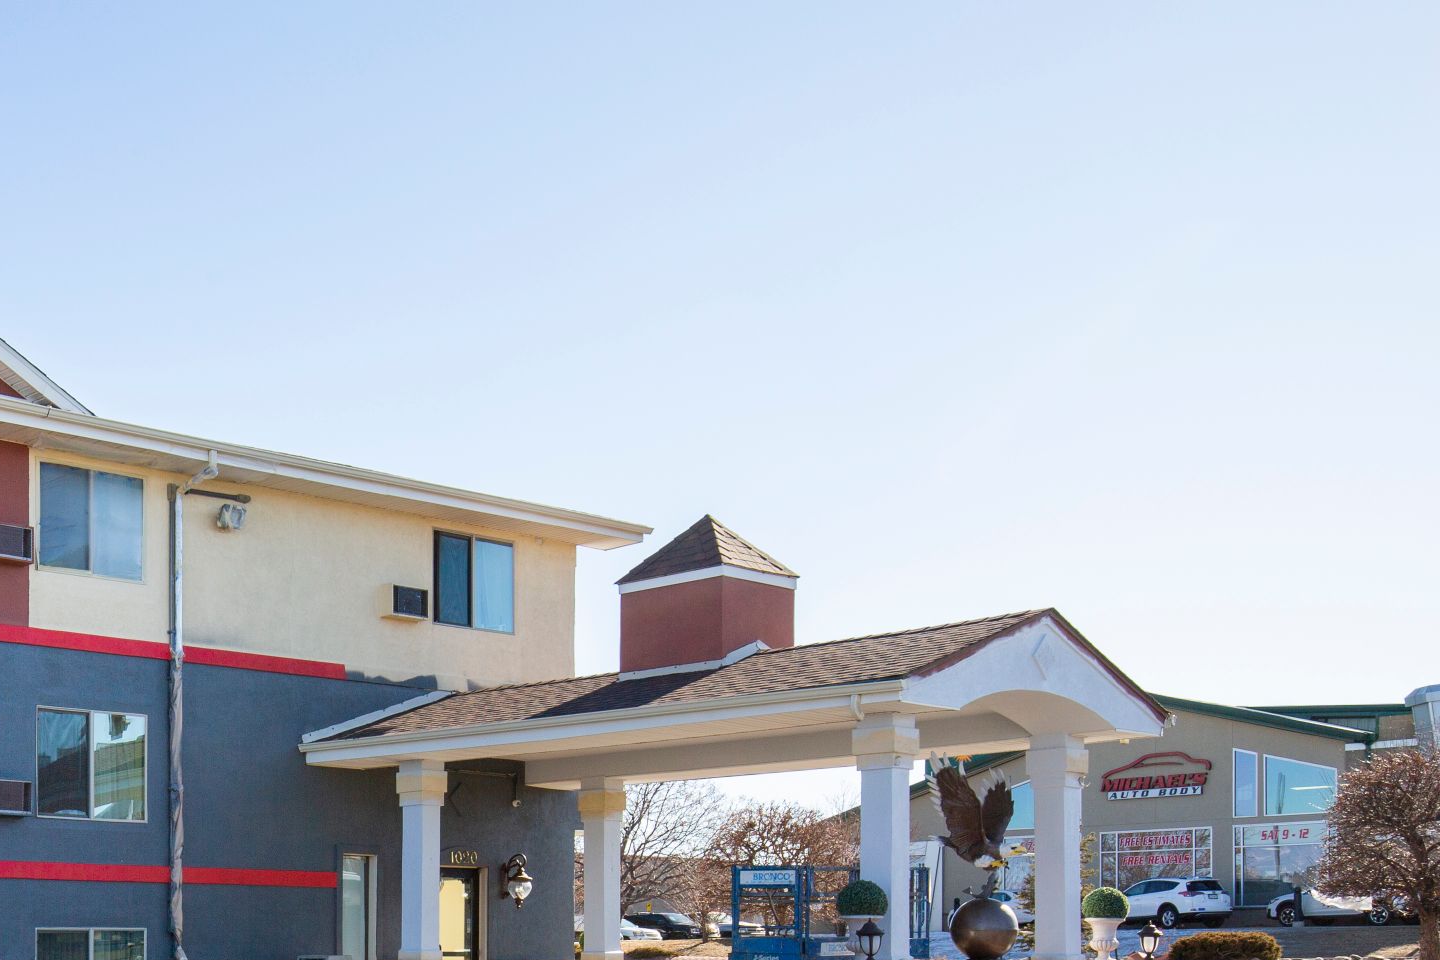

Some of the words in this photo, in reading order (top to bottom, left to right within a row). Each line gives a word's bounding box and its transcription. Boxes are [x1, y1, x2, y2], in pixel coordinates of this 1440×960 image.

[1101, 773, 1208, 792] MICHAEL'S
[1109, 790, 1150, 800] AUTO
[1159, 786, 1200, 796] BODY
[1119, 836, 1141, 848] FREE
[1142, 833, 1191, 847] ESTIMATES
[1260, 830, 1278, 840] SAT
[1282, 829, 1290, 839] 9
[1299, 828, 1309, 839] 12
[451, 850, 478, 864] 1020
[1122, 855, 1144, 866] FREE
[1147, 852, 1191, 865] RENTALS
[752, 872, 791, 882] BRONCO
